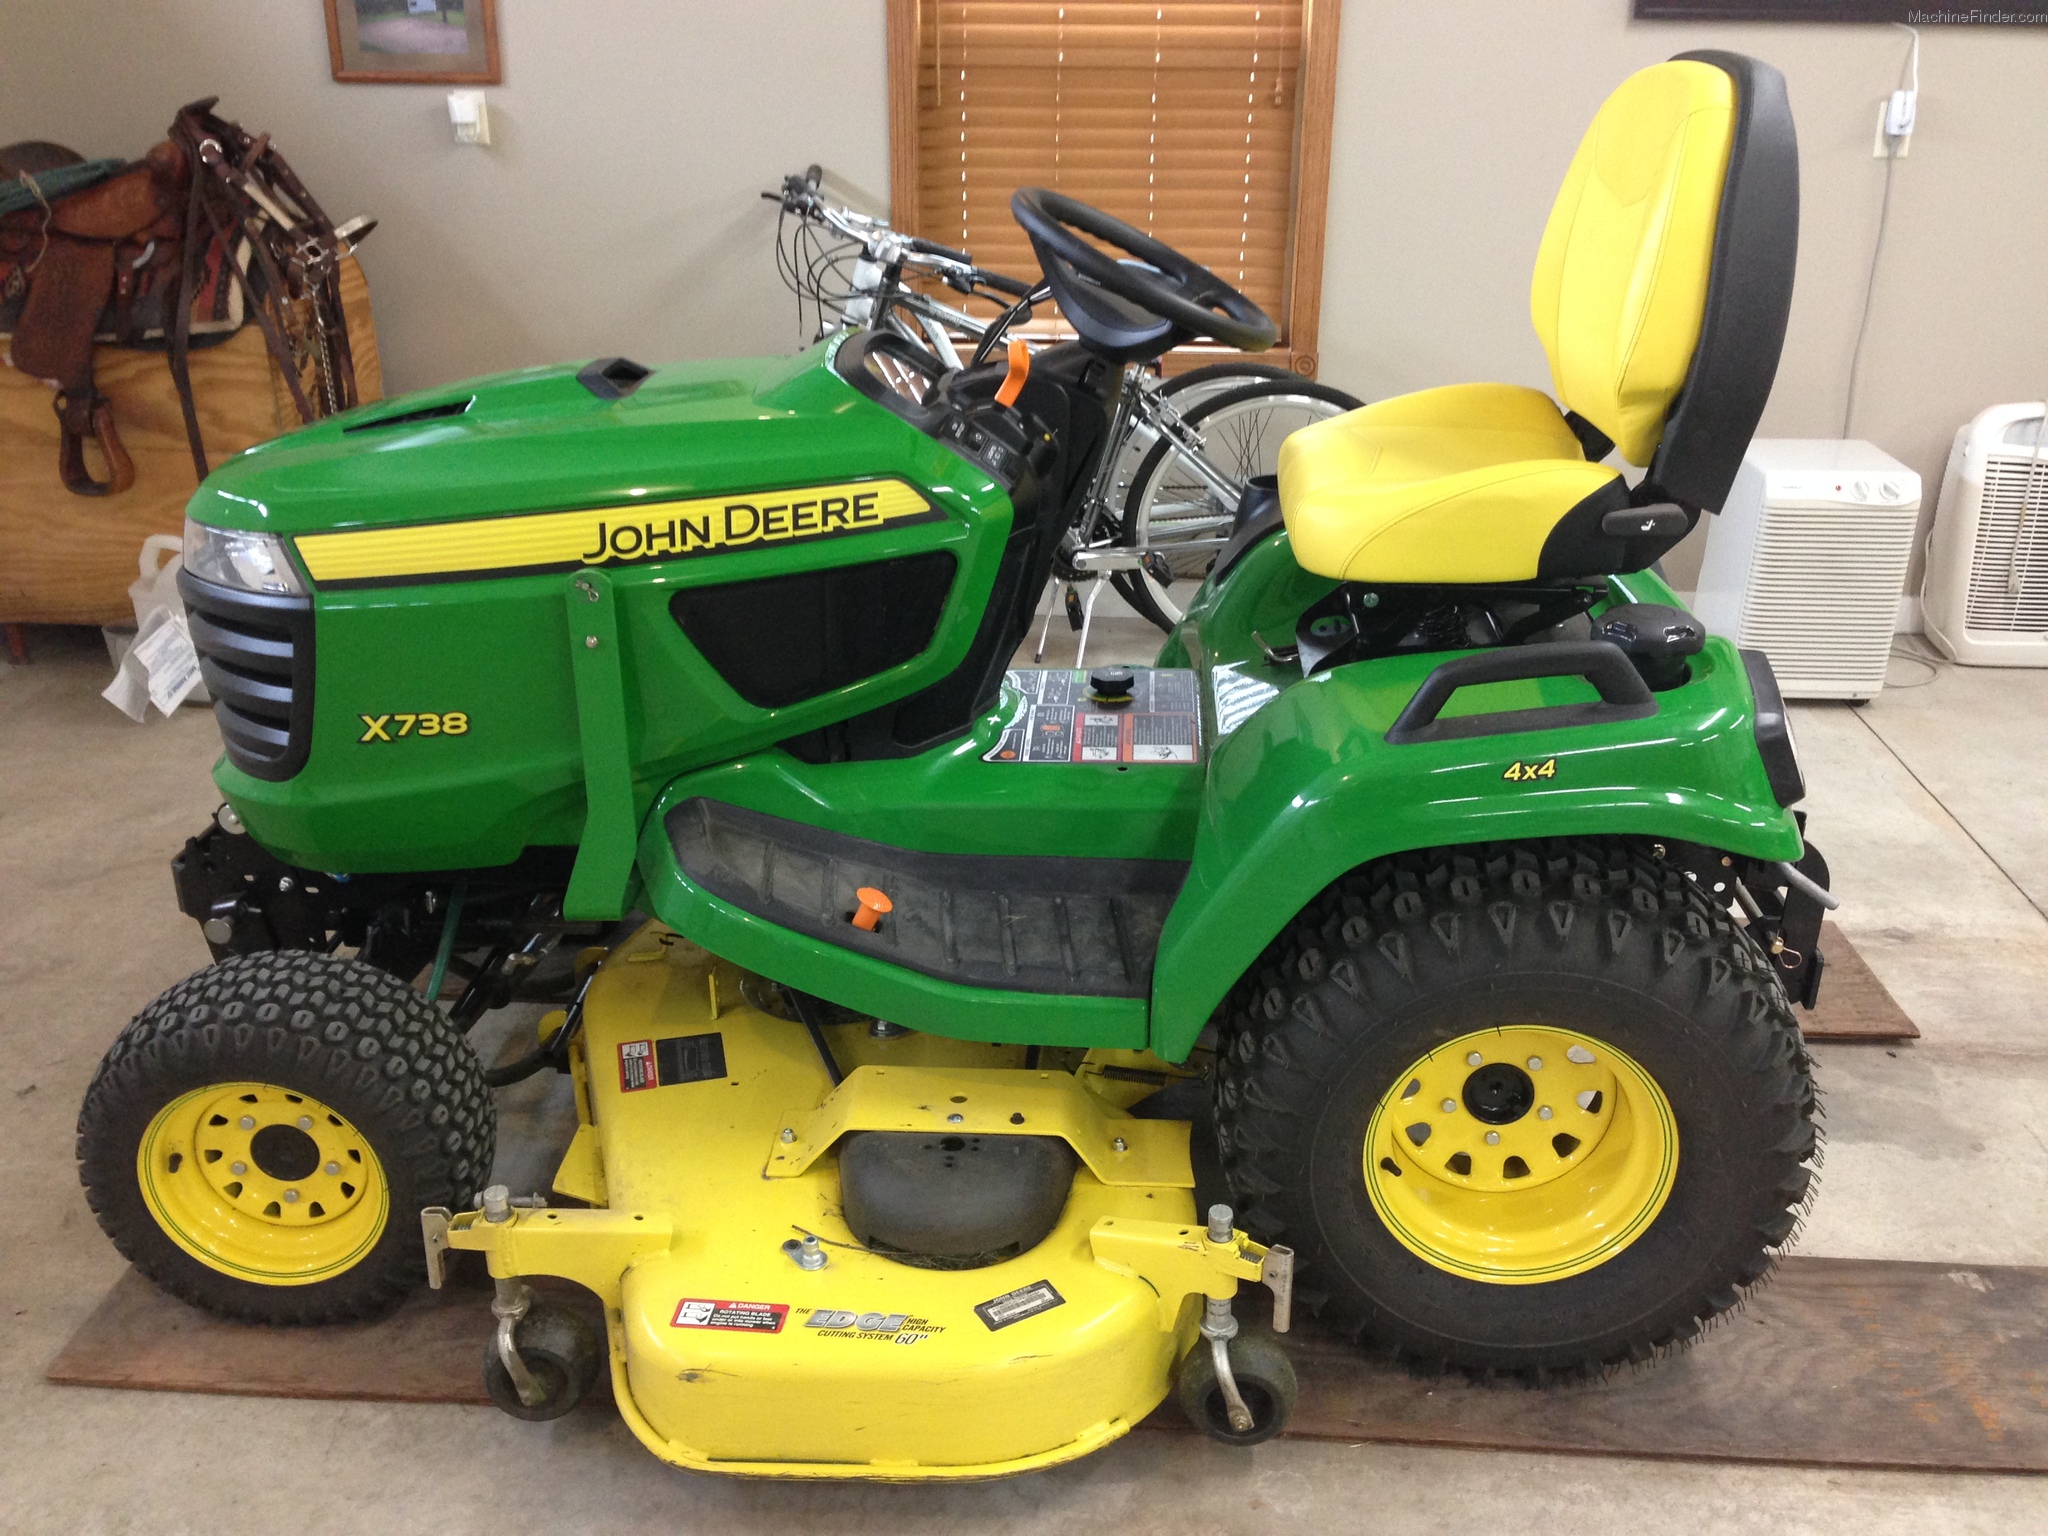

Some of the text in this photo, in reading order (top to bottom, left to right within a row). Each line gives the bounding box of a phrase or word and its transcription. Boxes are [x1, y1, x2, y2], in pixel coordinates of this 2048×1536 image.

[582, 492, 881, 561] JOHN DEERE
[358, 711, 469, 742] X738
[1503, 758, 1556, 781] 4x4
[795, 1307, 812, 1315] THE
[803, 1309, 908, 1333] EDGE
[817, 1329, 857, 1339] CUTTING
[856, 1332, 894, 1341] SYSTEM
[901, 1324, 946, 1334] CAPACITY
